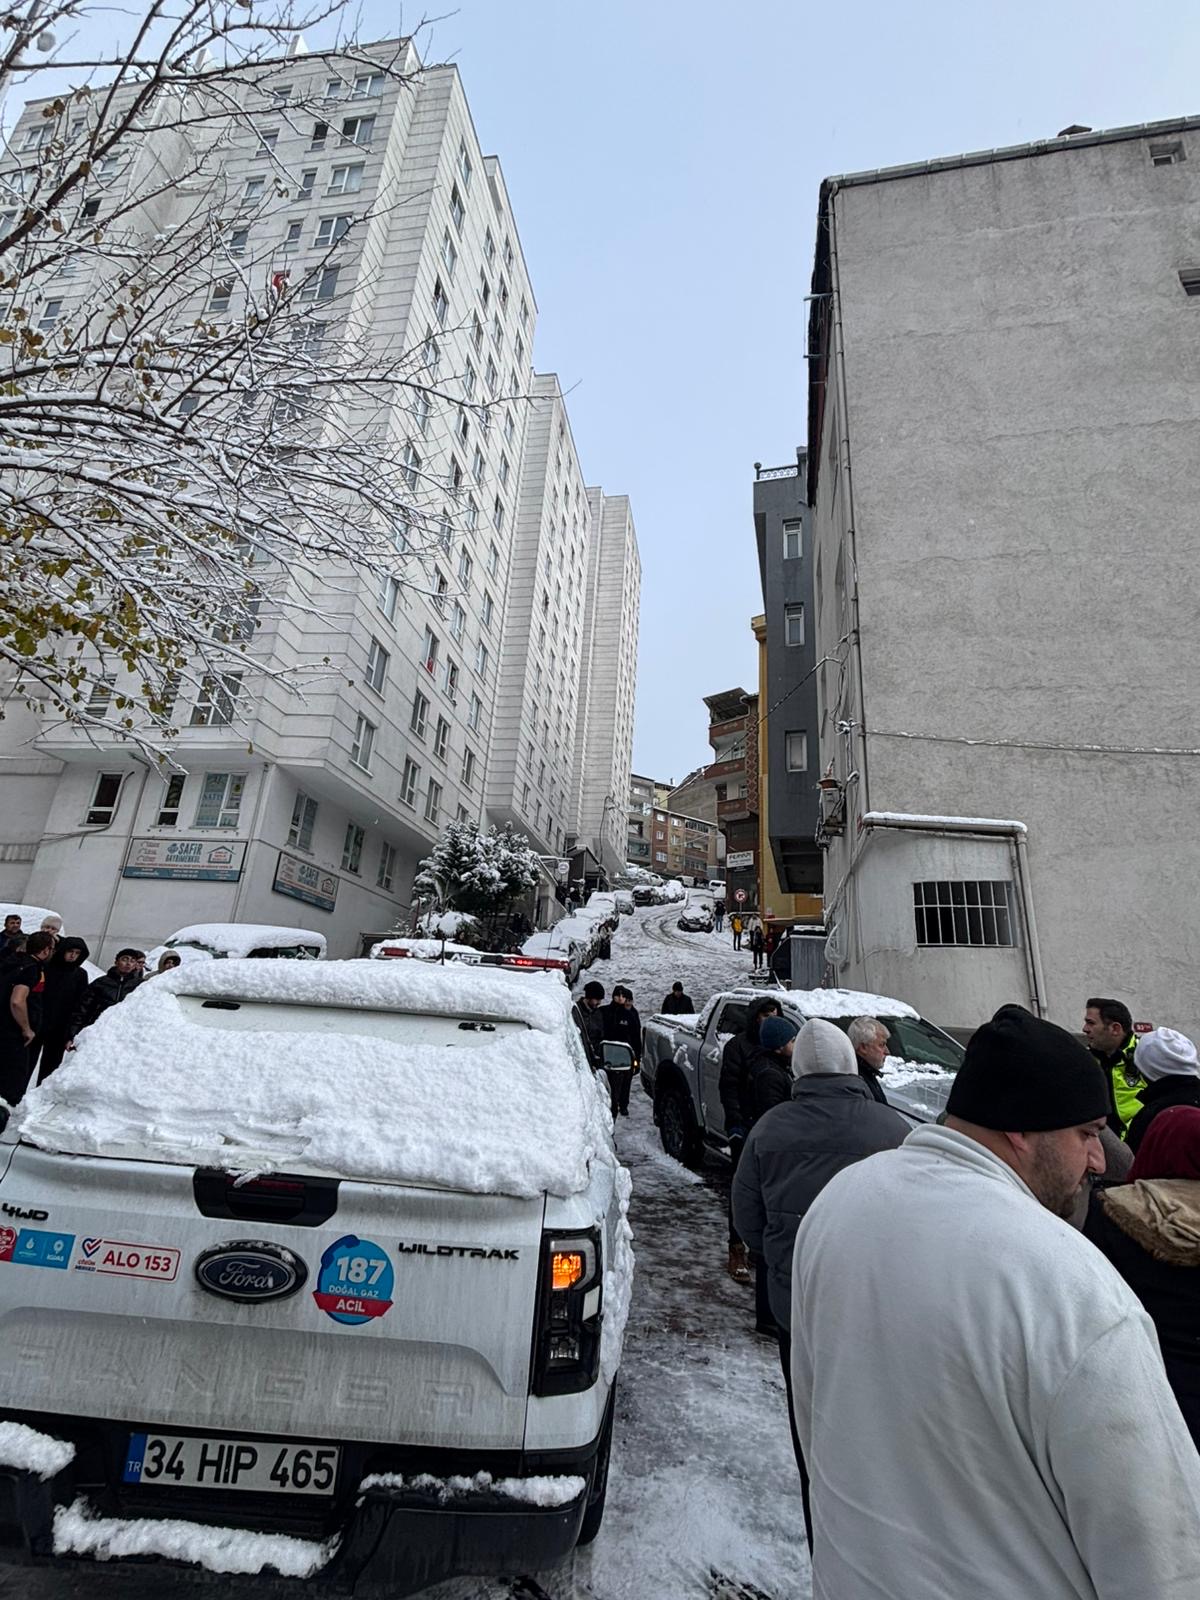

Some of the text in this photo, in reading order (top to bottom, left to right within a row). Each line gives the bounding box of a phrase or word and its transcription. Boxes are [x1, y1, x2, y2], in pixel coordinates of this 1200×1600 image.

[2, 1202, 49, 1221] 4WD
[398, 1242, 520, 1260] WILDTRAK
[102, 1250, 172, 1272] ALO 153
[337, 1256, 387, 1285] 187
[219, 1261, 272, 1288] Ford
[328, 1284, 379, 1298] DOĞAL GAZ
[336, 1299, 366, 1312] ACİL
[127, 1460, 141, 1473] TR
[144, 1439, 336, 1490] 34 HIP 465
